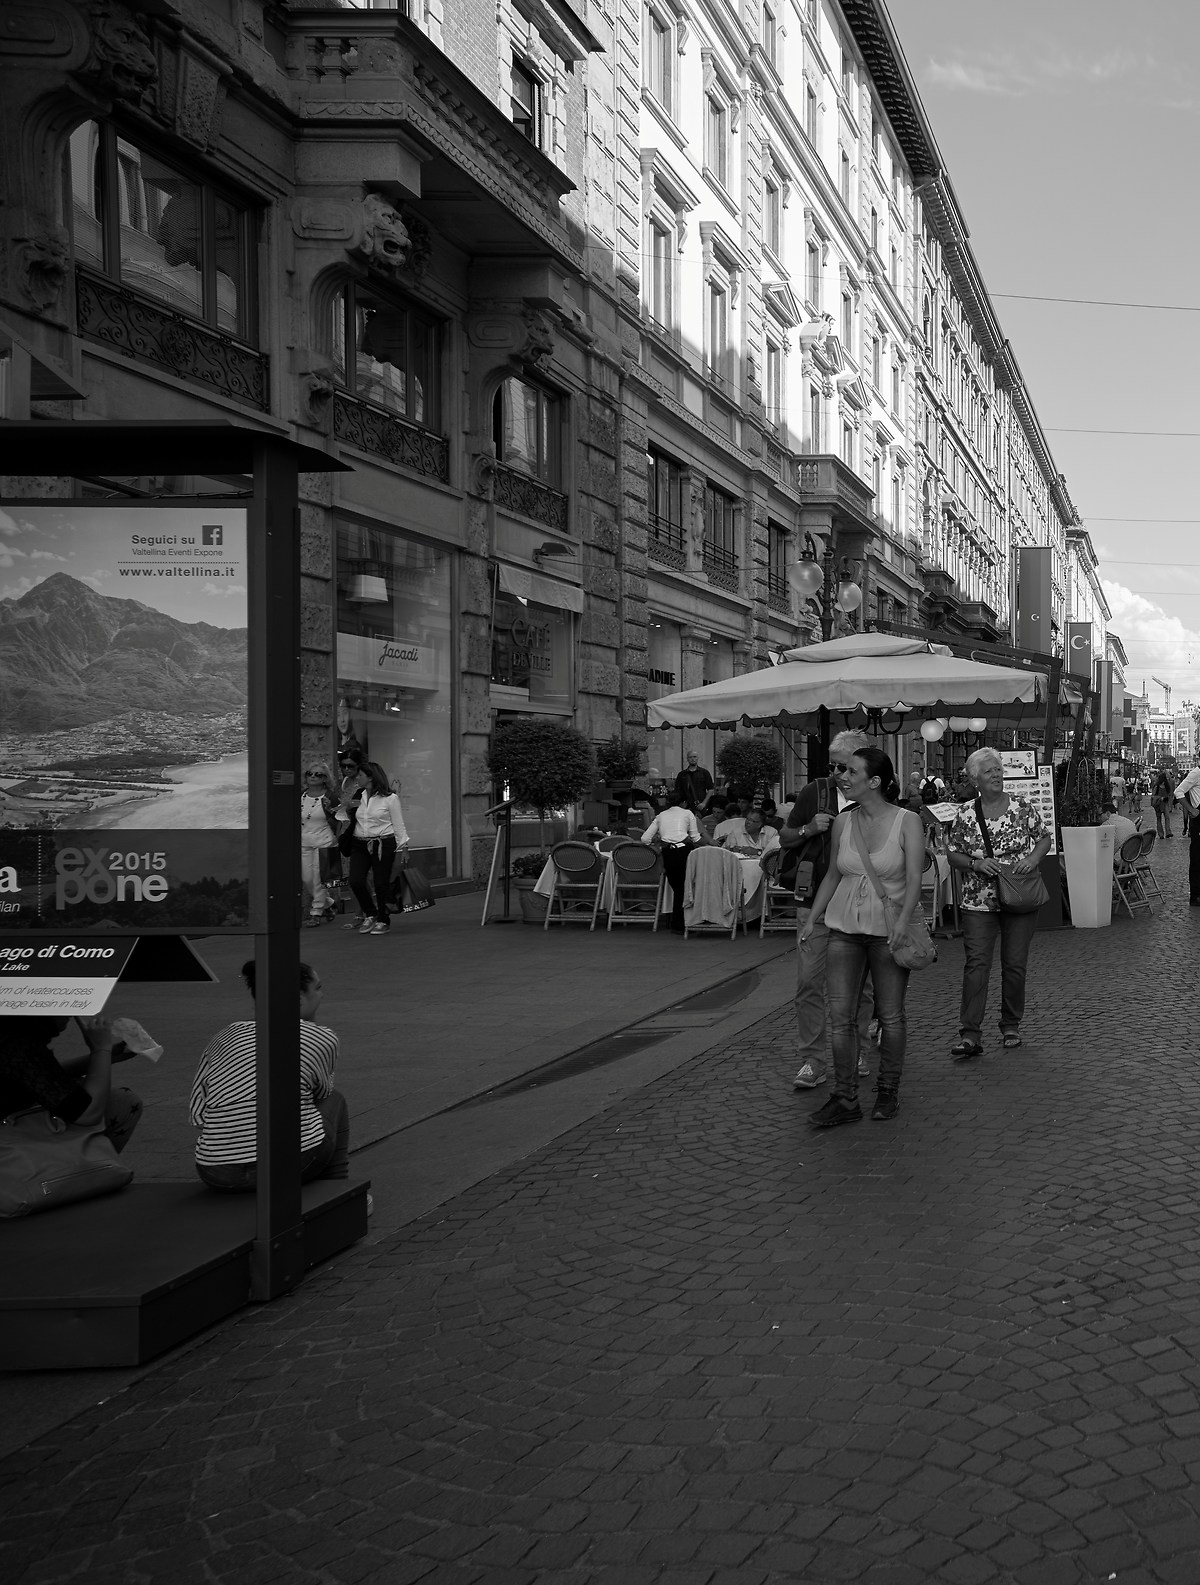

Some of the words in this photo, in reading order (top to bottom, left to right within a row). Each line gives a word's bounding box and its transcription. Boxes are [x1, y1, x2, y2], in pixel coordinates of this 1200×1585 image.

[131, 535, 177, 546] Seguici
[132, 548, 166, 556] Valtellina
[168, 548, 191, 556] Eventi
[194, 549, 223, 557] Expone
[119, 567, 235, 577] www.valtellina.it
[378, 641, 419, 666] jacadi
[108, 852, 167, 871] 2015
[37, 945, 59, 958] di
[59, 945, 115, 958] Como
[2, 963, 31, 971] Lake
[14, 985, 29, 995] of
[26, 987, 94, 996] watercourses
[29, 999, 58, 1008] basin
[58, 999, 70, 1008] in
[69, 999, 92, 1010] Italy
